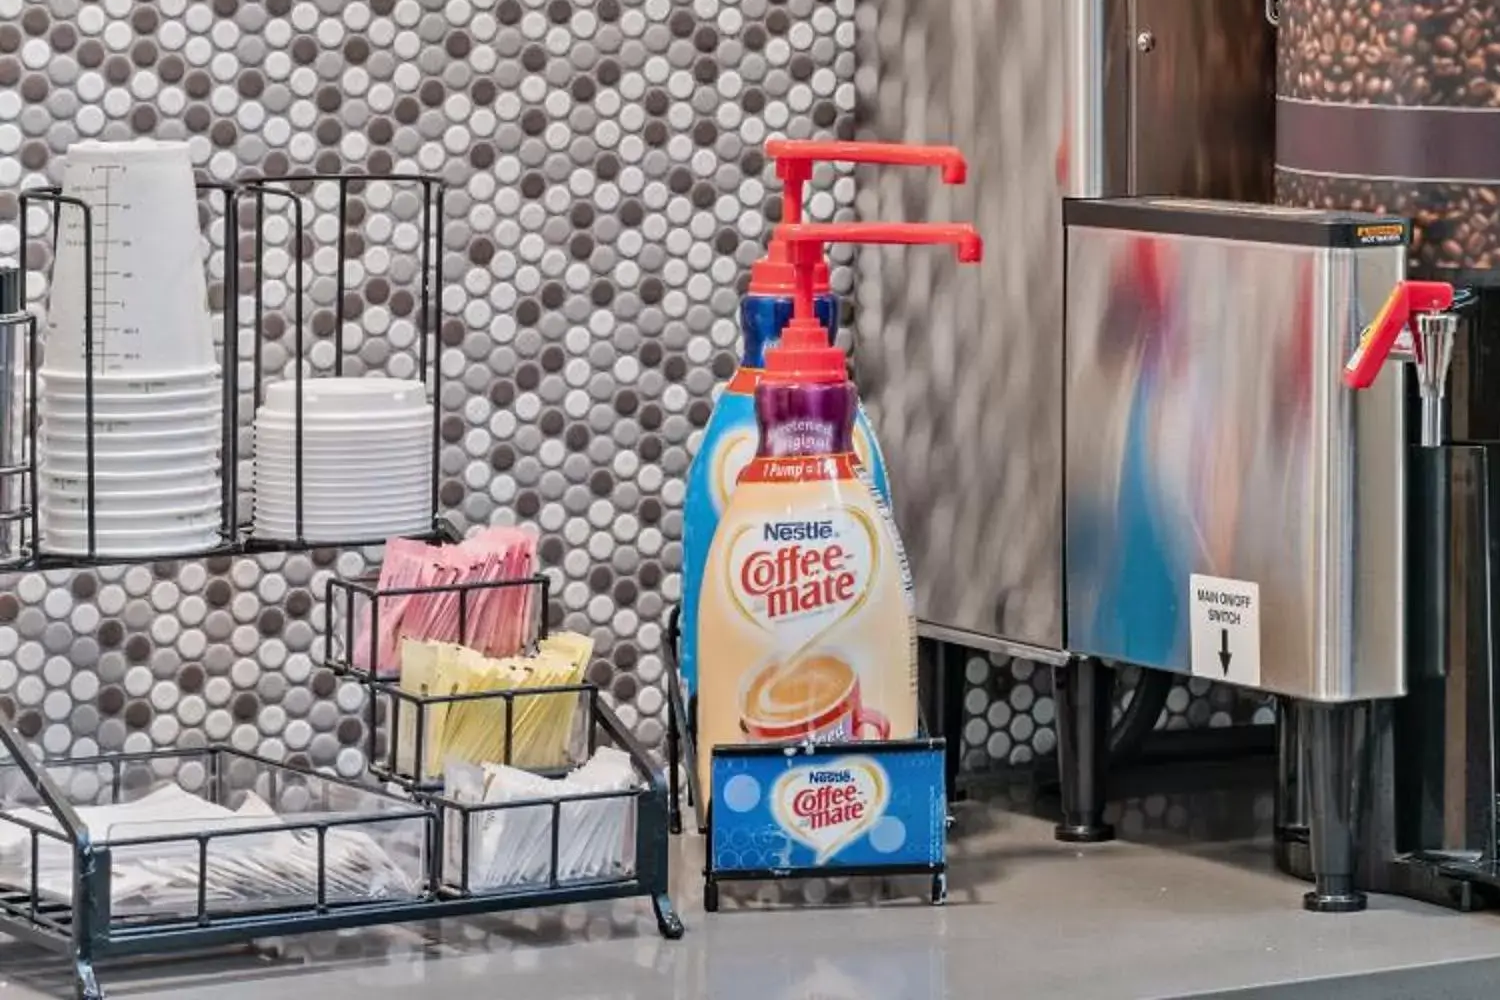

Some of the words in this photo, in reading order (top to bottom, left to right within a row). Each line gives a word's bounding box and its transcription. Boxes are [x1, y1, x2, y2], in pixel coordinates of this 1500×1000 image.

[769, 461, 804, 477] Pump
[764, 520, 833, 541] Nestlé
[767, 571, 855, 618] mate
[1197, 588, 1218, 604] MAIN
[1208, 608, 1241, 625] SWITCH
[810, 801, 865, 830] mate
